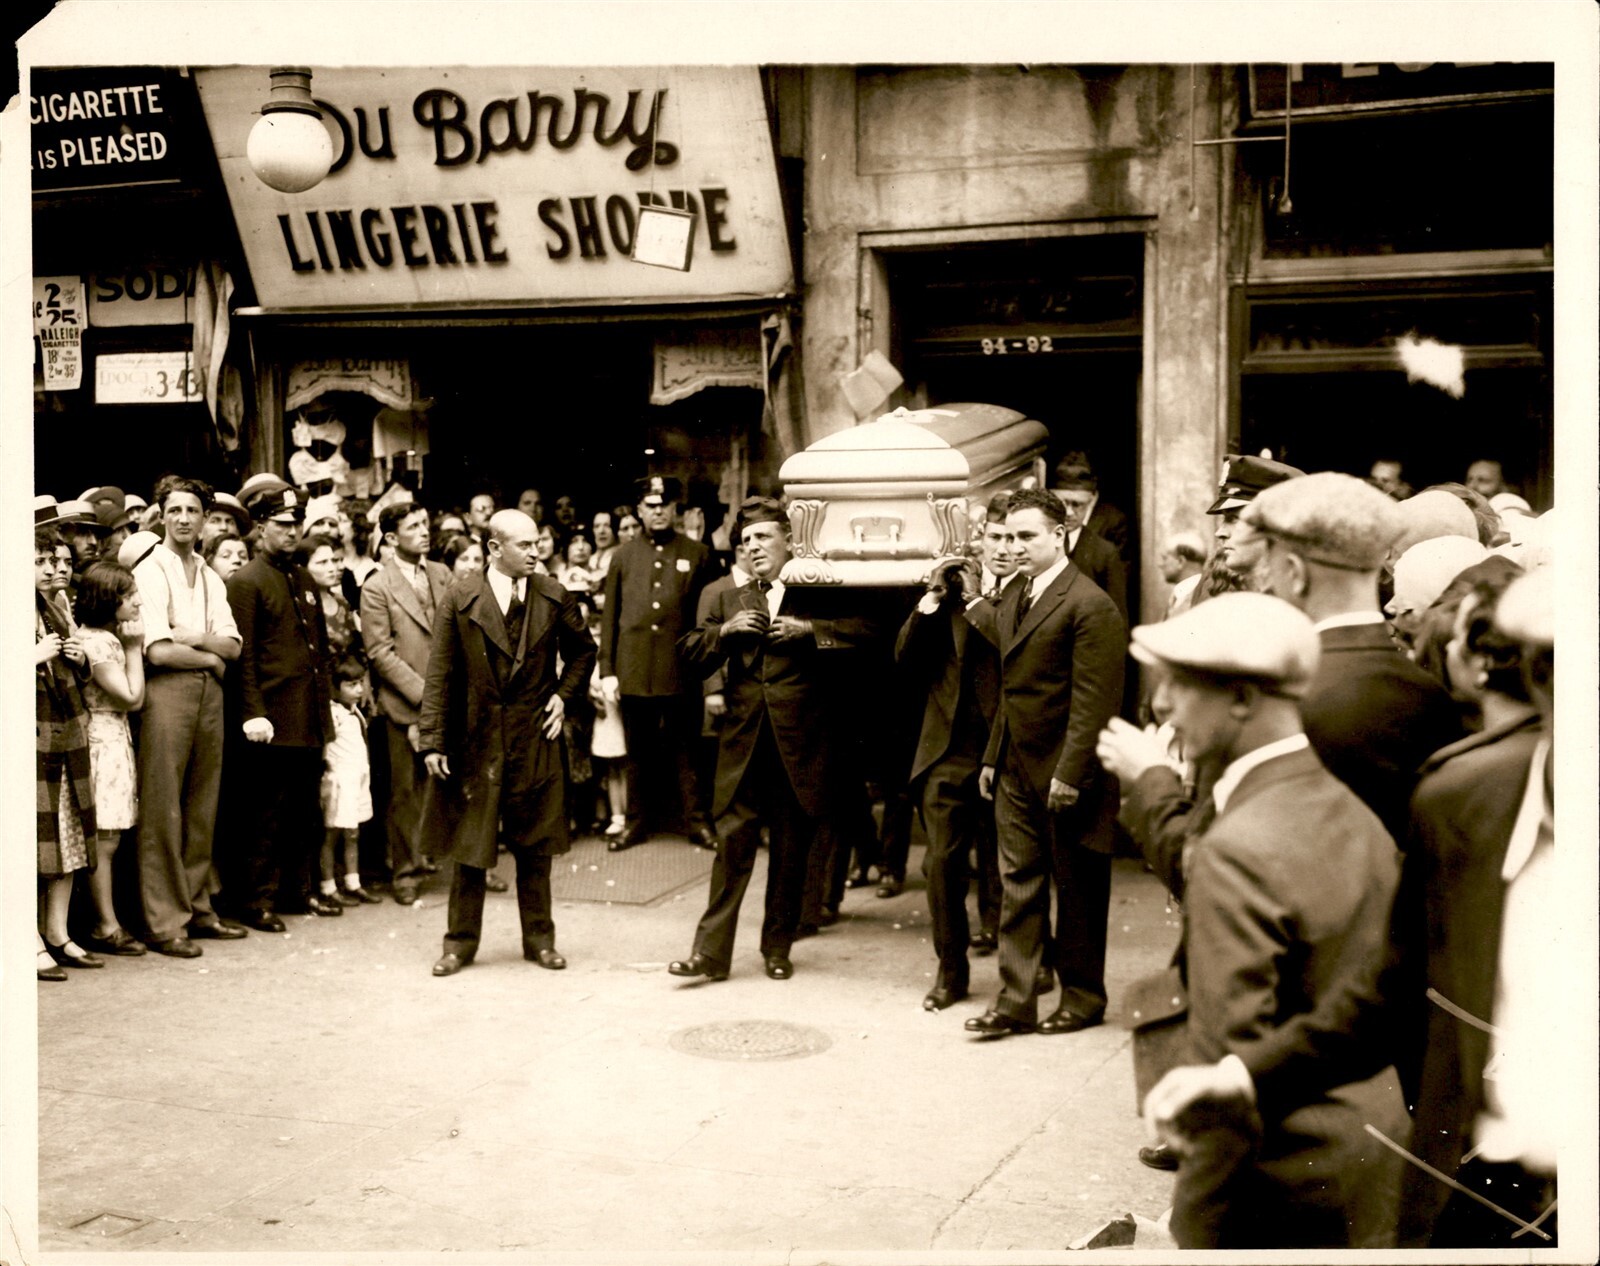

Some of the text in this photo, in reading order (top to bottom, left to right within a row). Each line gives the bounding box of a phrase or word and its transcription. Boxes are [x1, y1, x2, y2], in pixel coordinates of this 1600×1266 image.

[31, 84, 163, 124] CIGARETTE
[413, 88, 679, 171] Barry
[38, 132, 167, 169] IS PLEASED
[278, 201, 508, 271] LINGERIE
[45, 283, 61, 308] 2
[41, 327, 79, 340] RALEIGH
[42, 340, 79, 348] CIGARETTES
